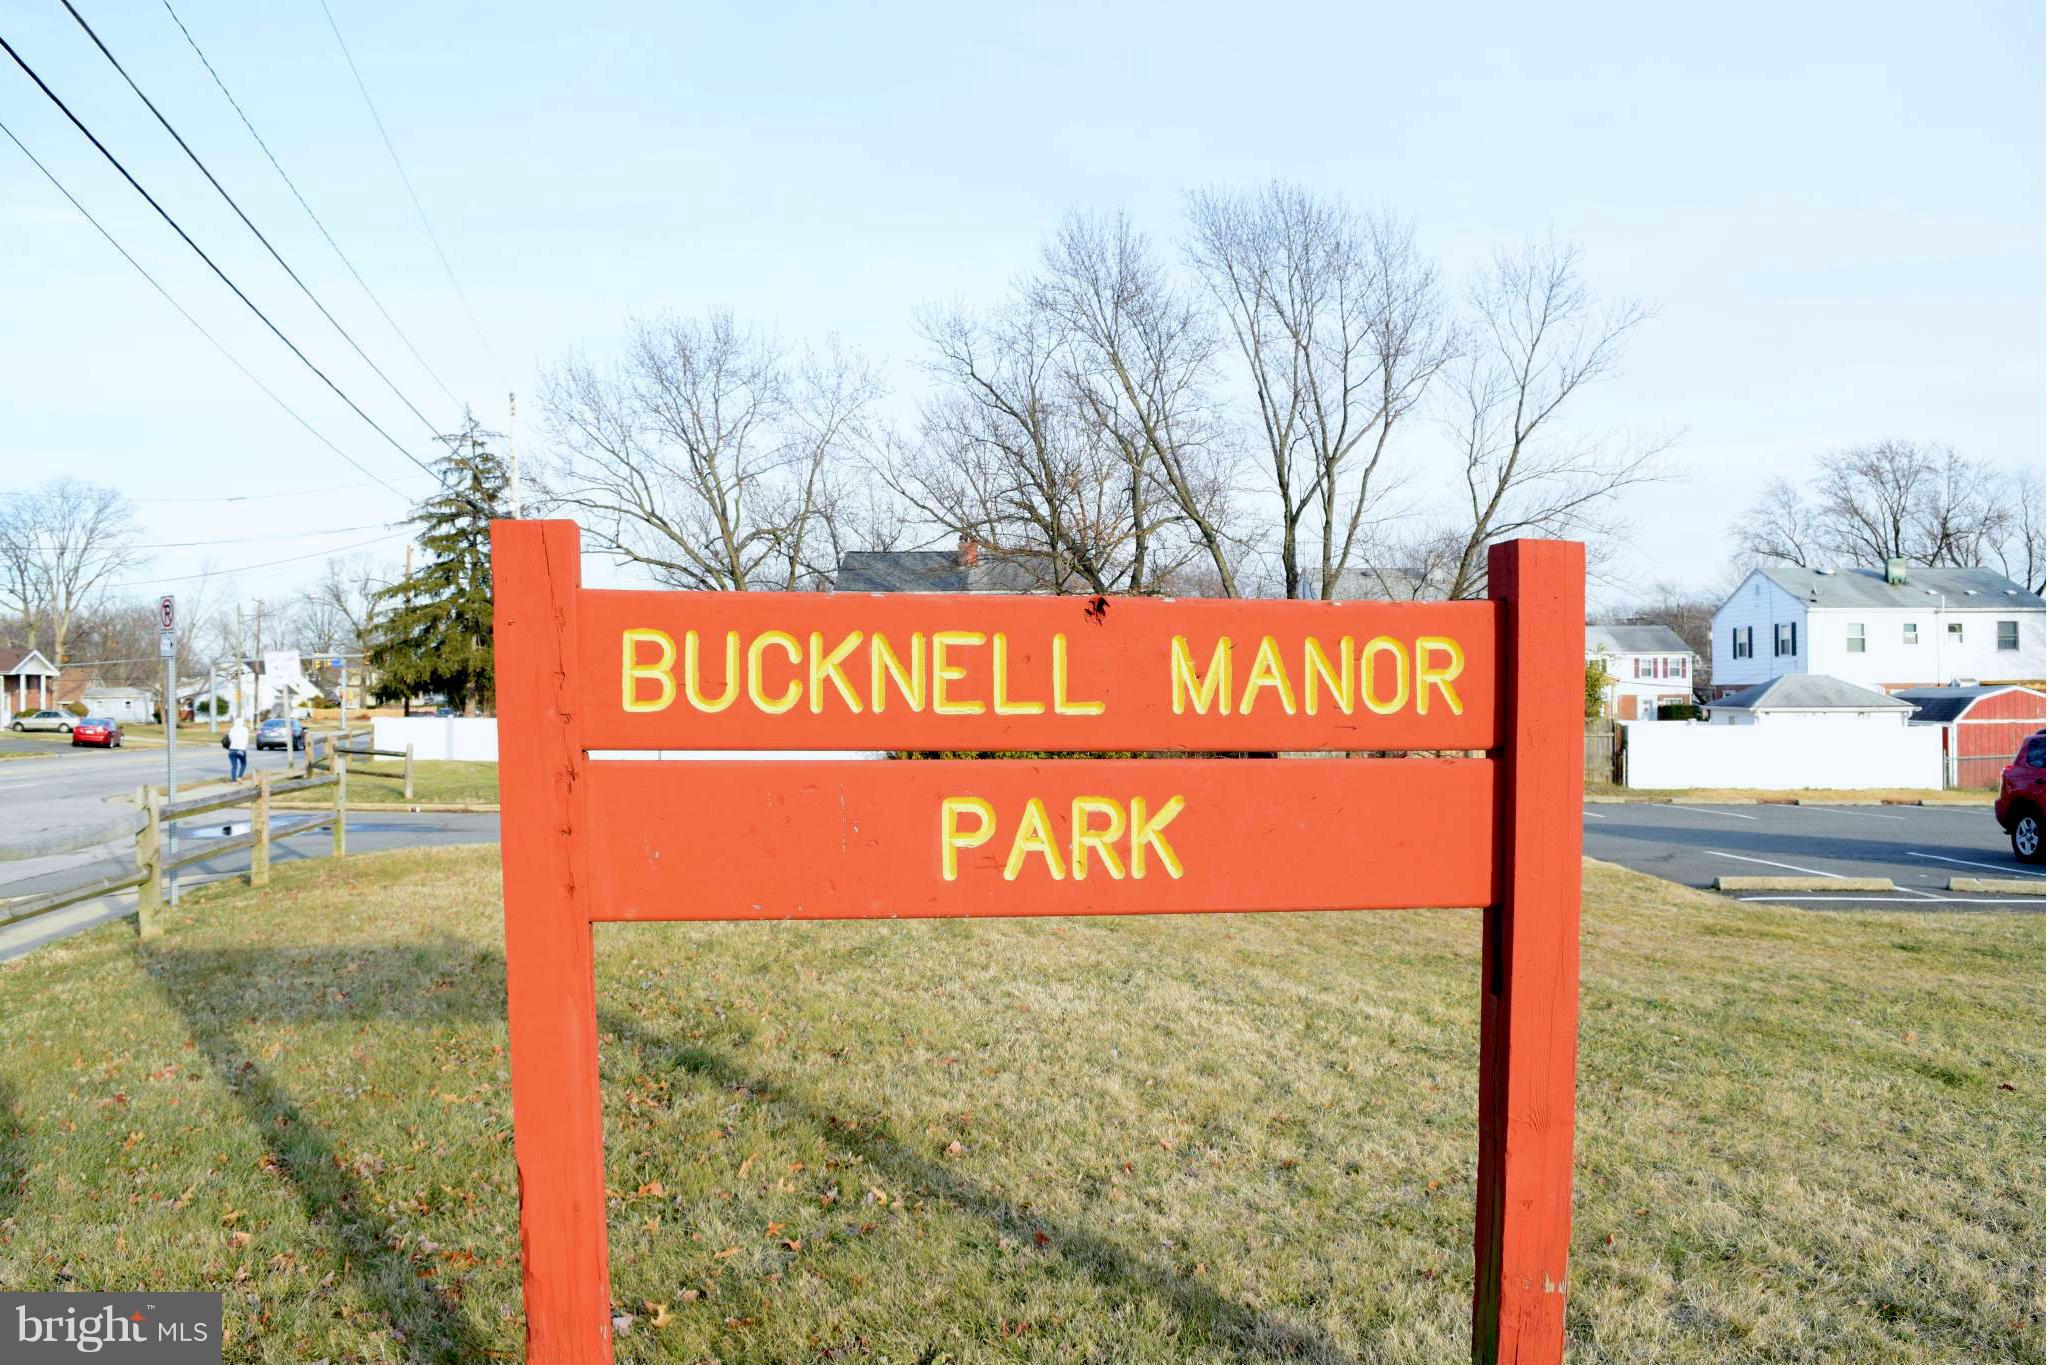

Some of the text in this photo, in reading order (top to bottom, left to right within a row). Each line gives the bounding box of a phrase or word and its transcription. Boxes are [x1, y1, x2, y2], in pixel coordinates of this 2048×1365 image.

[621, 628, 1465, 715] BUCKNELL MANOR
[941, 795, 1185, 881] PARK
